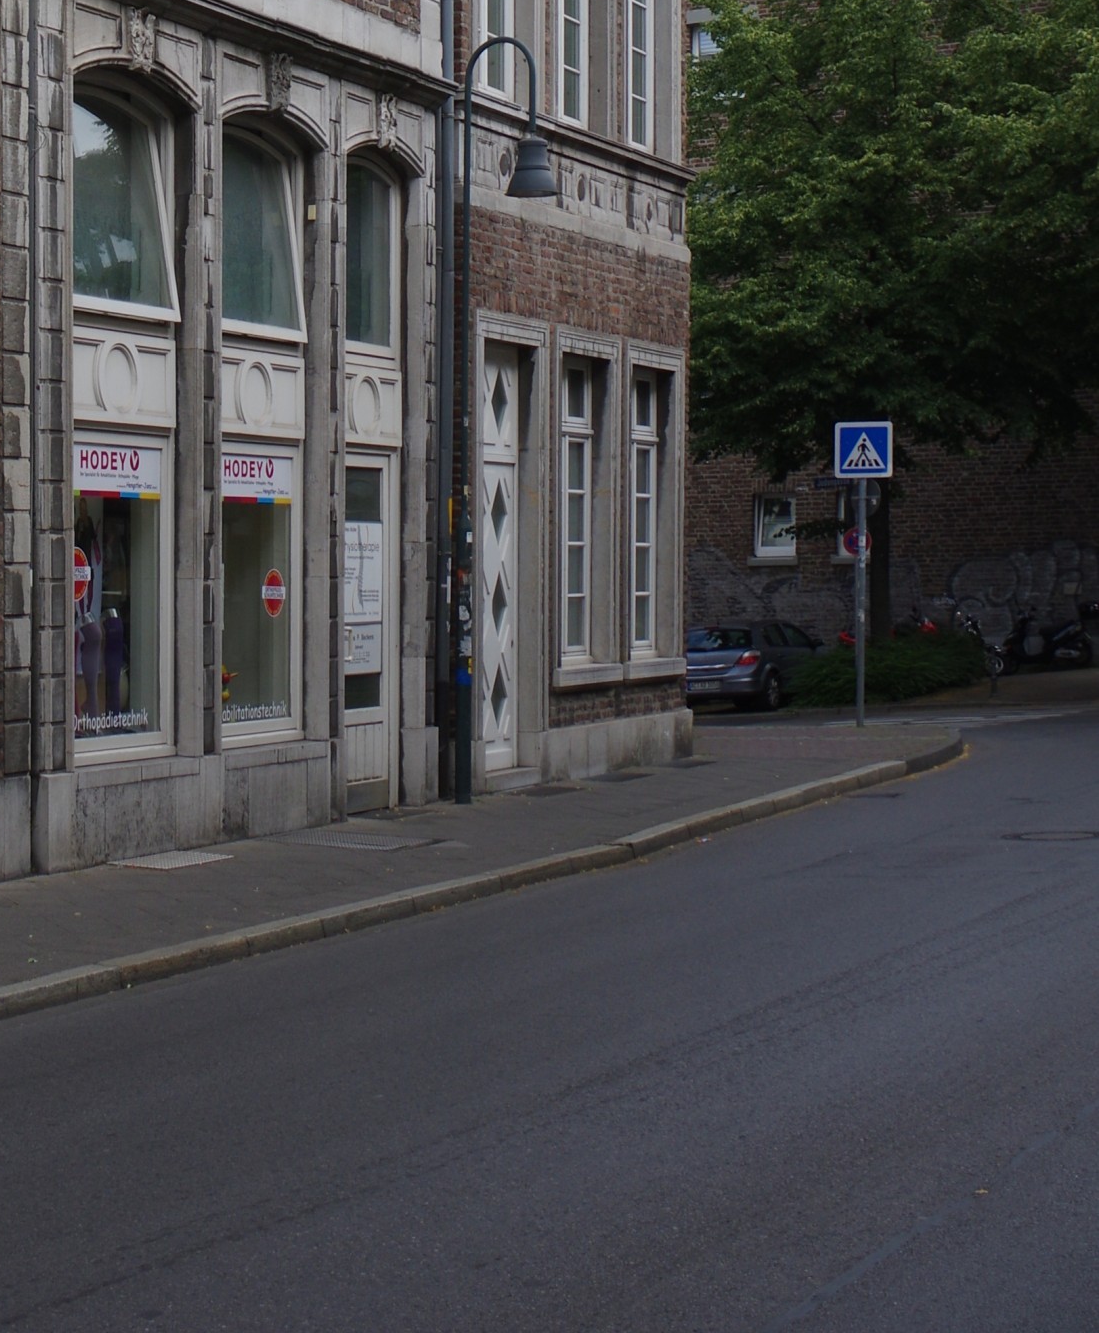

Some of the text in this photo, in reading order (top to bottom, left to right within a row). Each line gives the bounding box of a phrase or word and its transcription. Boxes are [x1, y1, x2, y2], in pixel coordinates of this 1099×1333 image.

[80, 449, 127, 471] HODEY
[224, 459, 264, 478] HODEY
[73, 706, 149, 735] Orthopädietechnik
[221, 700, 287, 723] abilitationstechnik
